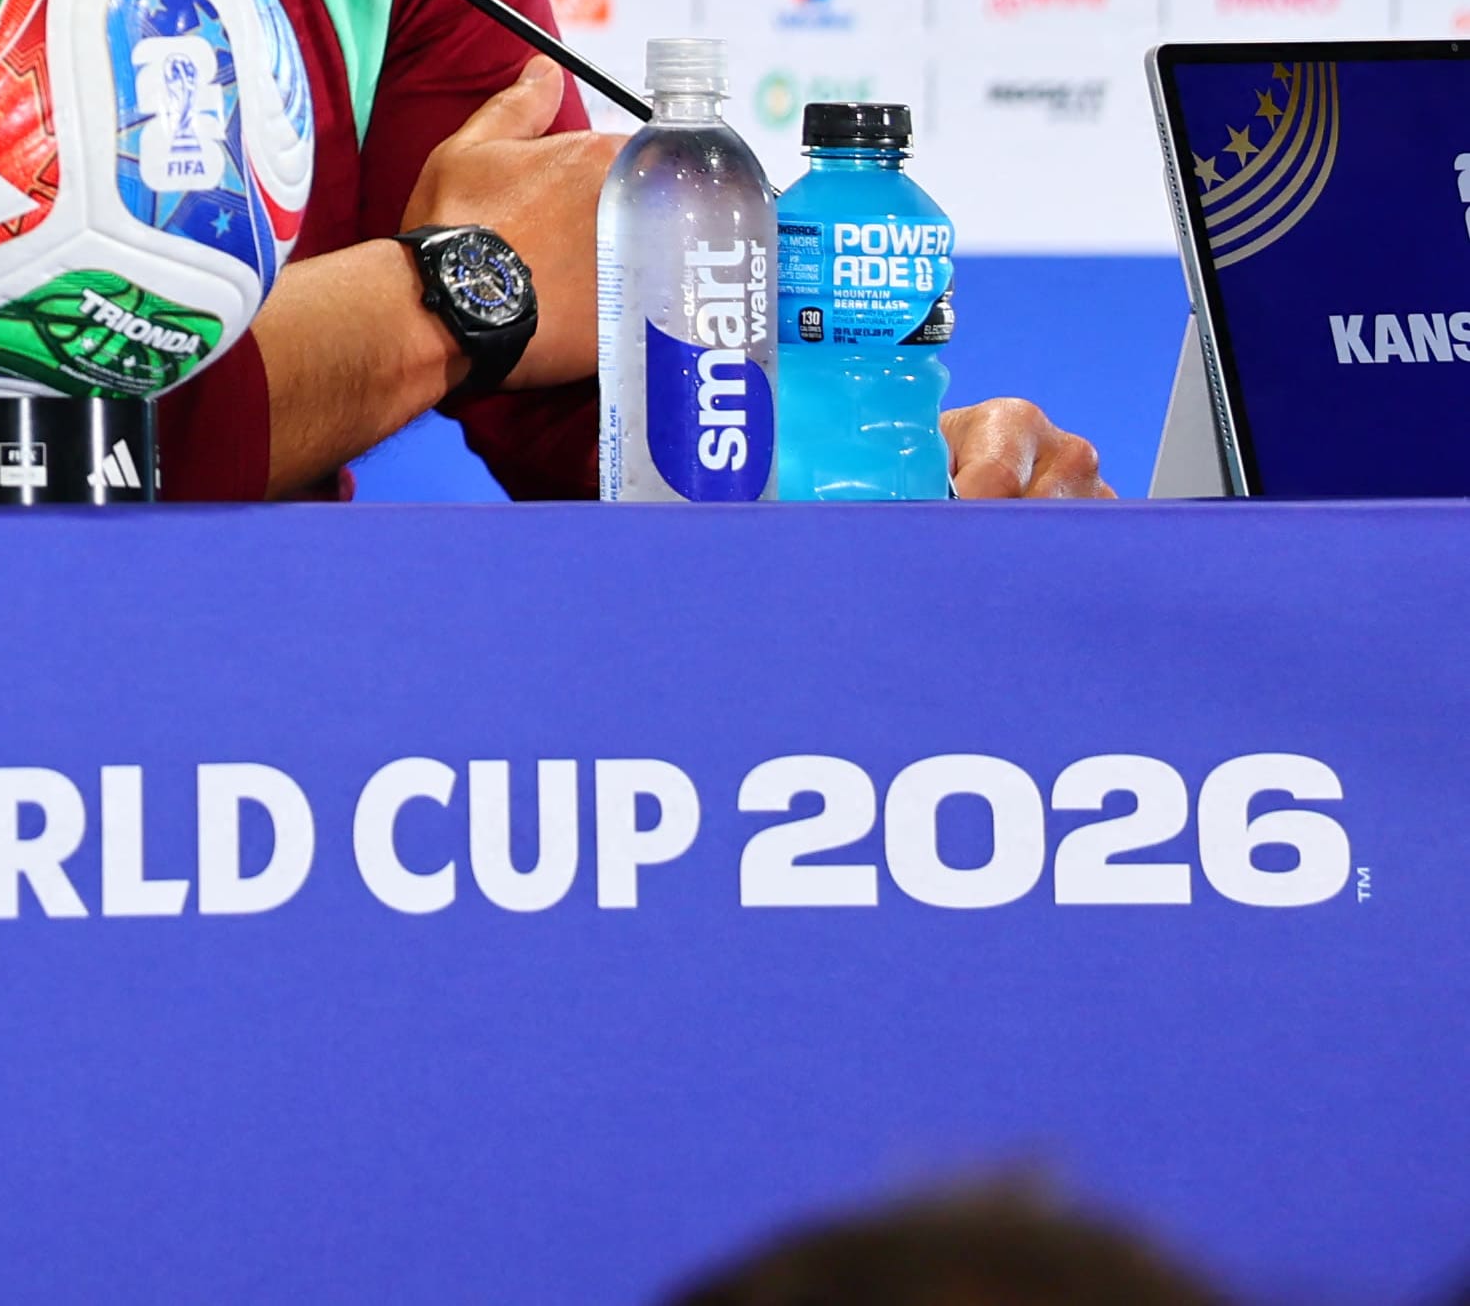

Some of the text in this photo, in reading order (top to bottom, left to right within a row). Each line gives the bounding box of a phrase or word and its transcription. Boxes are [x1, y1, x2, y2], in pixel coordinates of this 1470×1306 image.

[167, 160, 206, 176] FIFA
[833, 223, 950, 255] POWER
[747, 240, 767, 343] water
[833, 255, 909, 286] ADE
[833, 290, 891, 299] MOUNTAIN
[78, 288, 201, 355] TRIONDA
[801, 311, 821, 325] 130
[1329, 312, 1470, 365] KANS
[684, 240, 747, 471] smart
[352, 756, 701, 915] CUP
[734, 752, 1352, 910] 2026
[1356, 867, 1372, 904] TM
